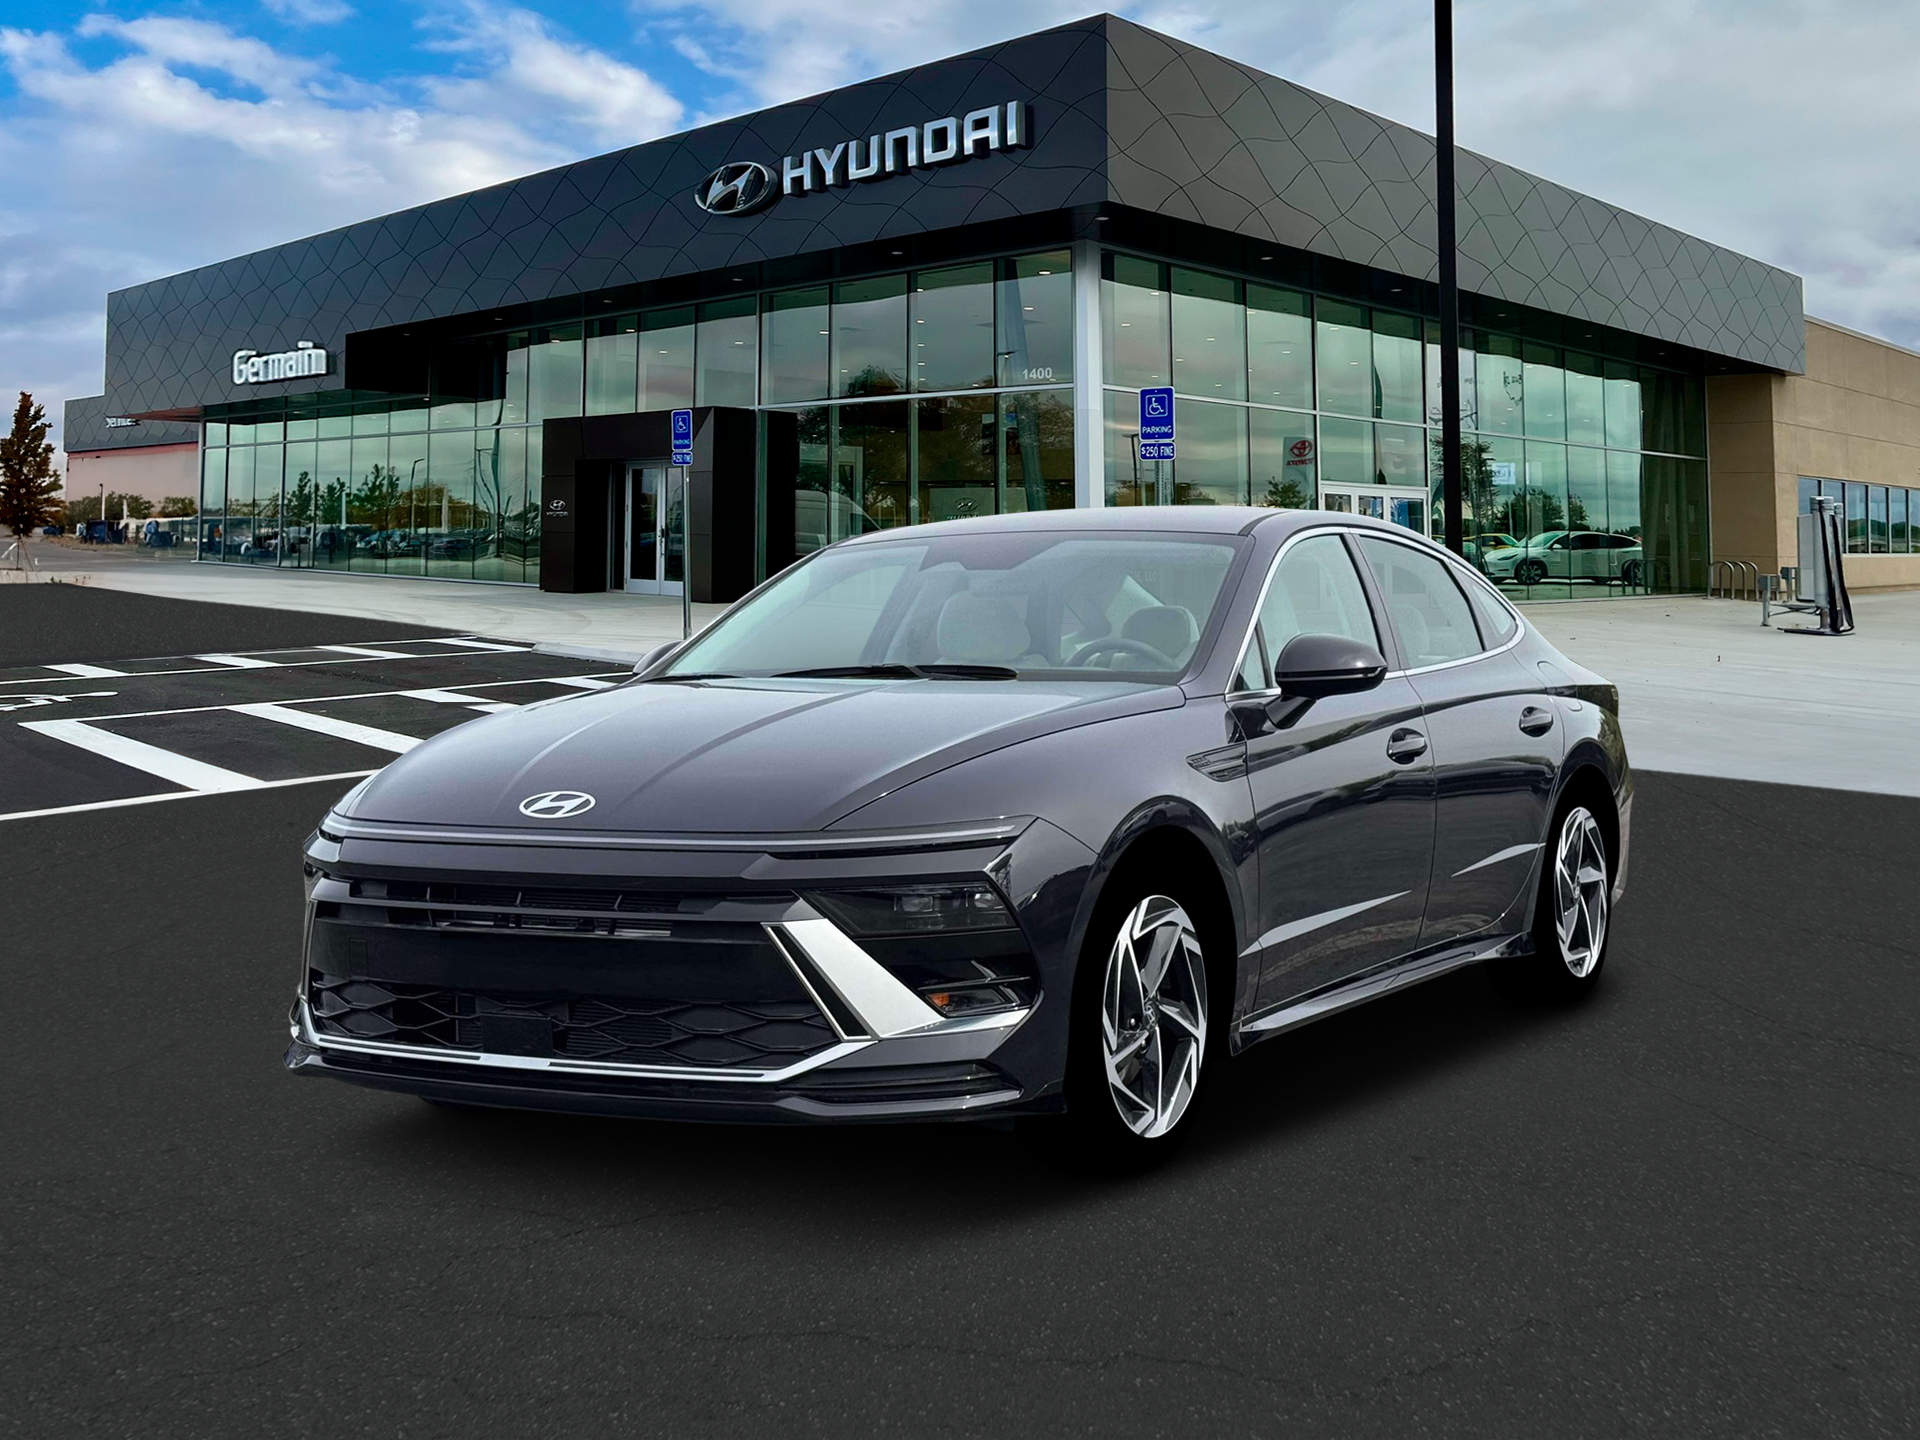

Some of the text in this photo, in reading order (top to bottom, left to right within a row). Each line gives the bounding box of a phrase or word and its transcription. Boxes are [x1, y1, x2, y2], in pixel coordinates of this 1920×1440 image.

[782, 100, 1026, 196] HYUNDAI
[233, 340, 328, 385] Germain
[1022, 366, 1053, 380] 1400
[1142, 425, 1172, 434] PARKING
[1141, 446, 1174, 457] $250 FINE
